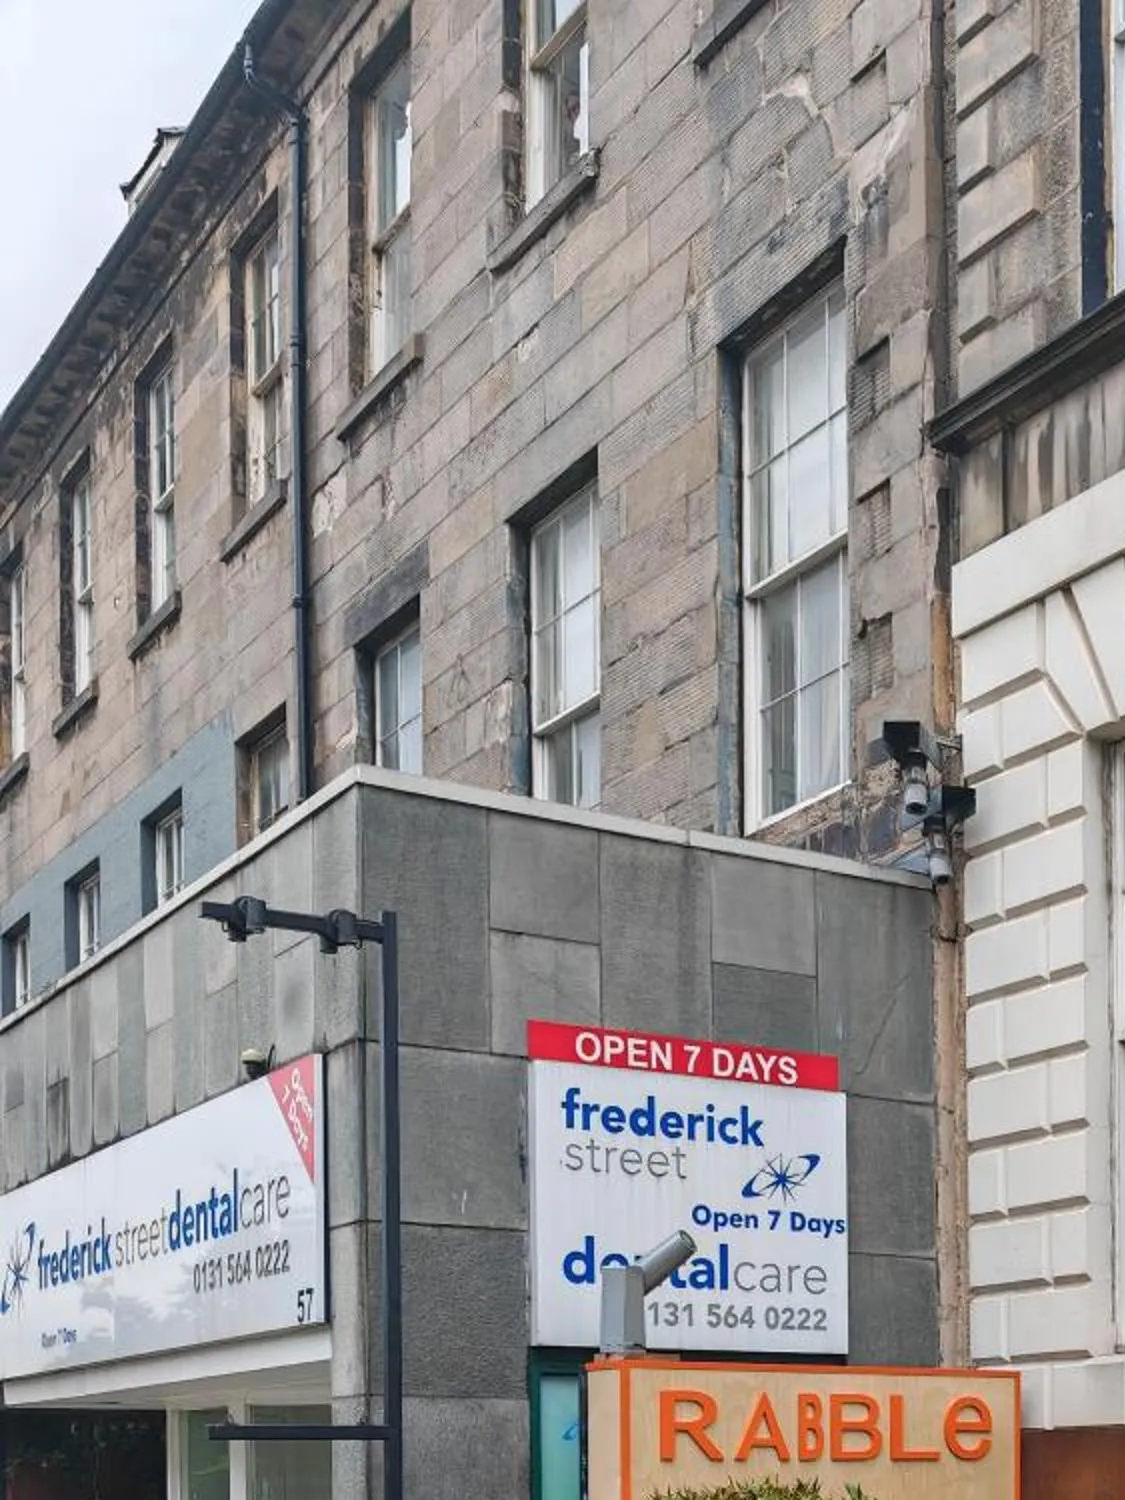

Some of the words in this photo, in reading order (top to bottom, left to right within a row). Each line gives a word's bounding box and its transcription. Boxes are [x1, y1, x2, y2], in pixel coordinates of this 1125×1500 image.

[575, 1032, 672, 1072] OPEN
[683, 1045, 700, 1080] 7
[713, 1049, 799, 1085] DAYS
[560, 1087, 765, 1147] frederick
[564, 1138, 687, 1180] street
[692, 1205, 759, 1232] Open
[767, 1210, 781, 1230] 7
[790, 1211, 846, 1238] Days
[193, 1258, 223, 1294] 0131
[227, 1248, 251, 1286] 564
[255, 1239, 291, 1279] 0222
[562, 1235, 828, 1295] dalcare
[297, 1287, 315, 1323] 57
[648, 1302, 694, 1328] 131
[707, 1303, 756, 1330] 564
[765, 1307, 828, 1331] 0222
